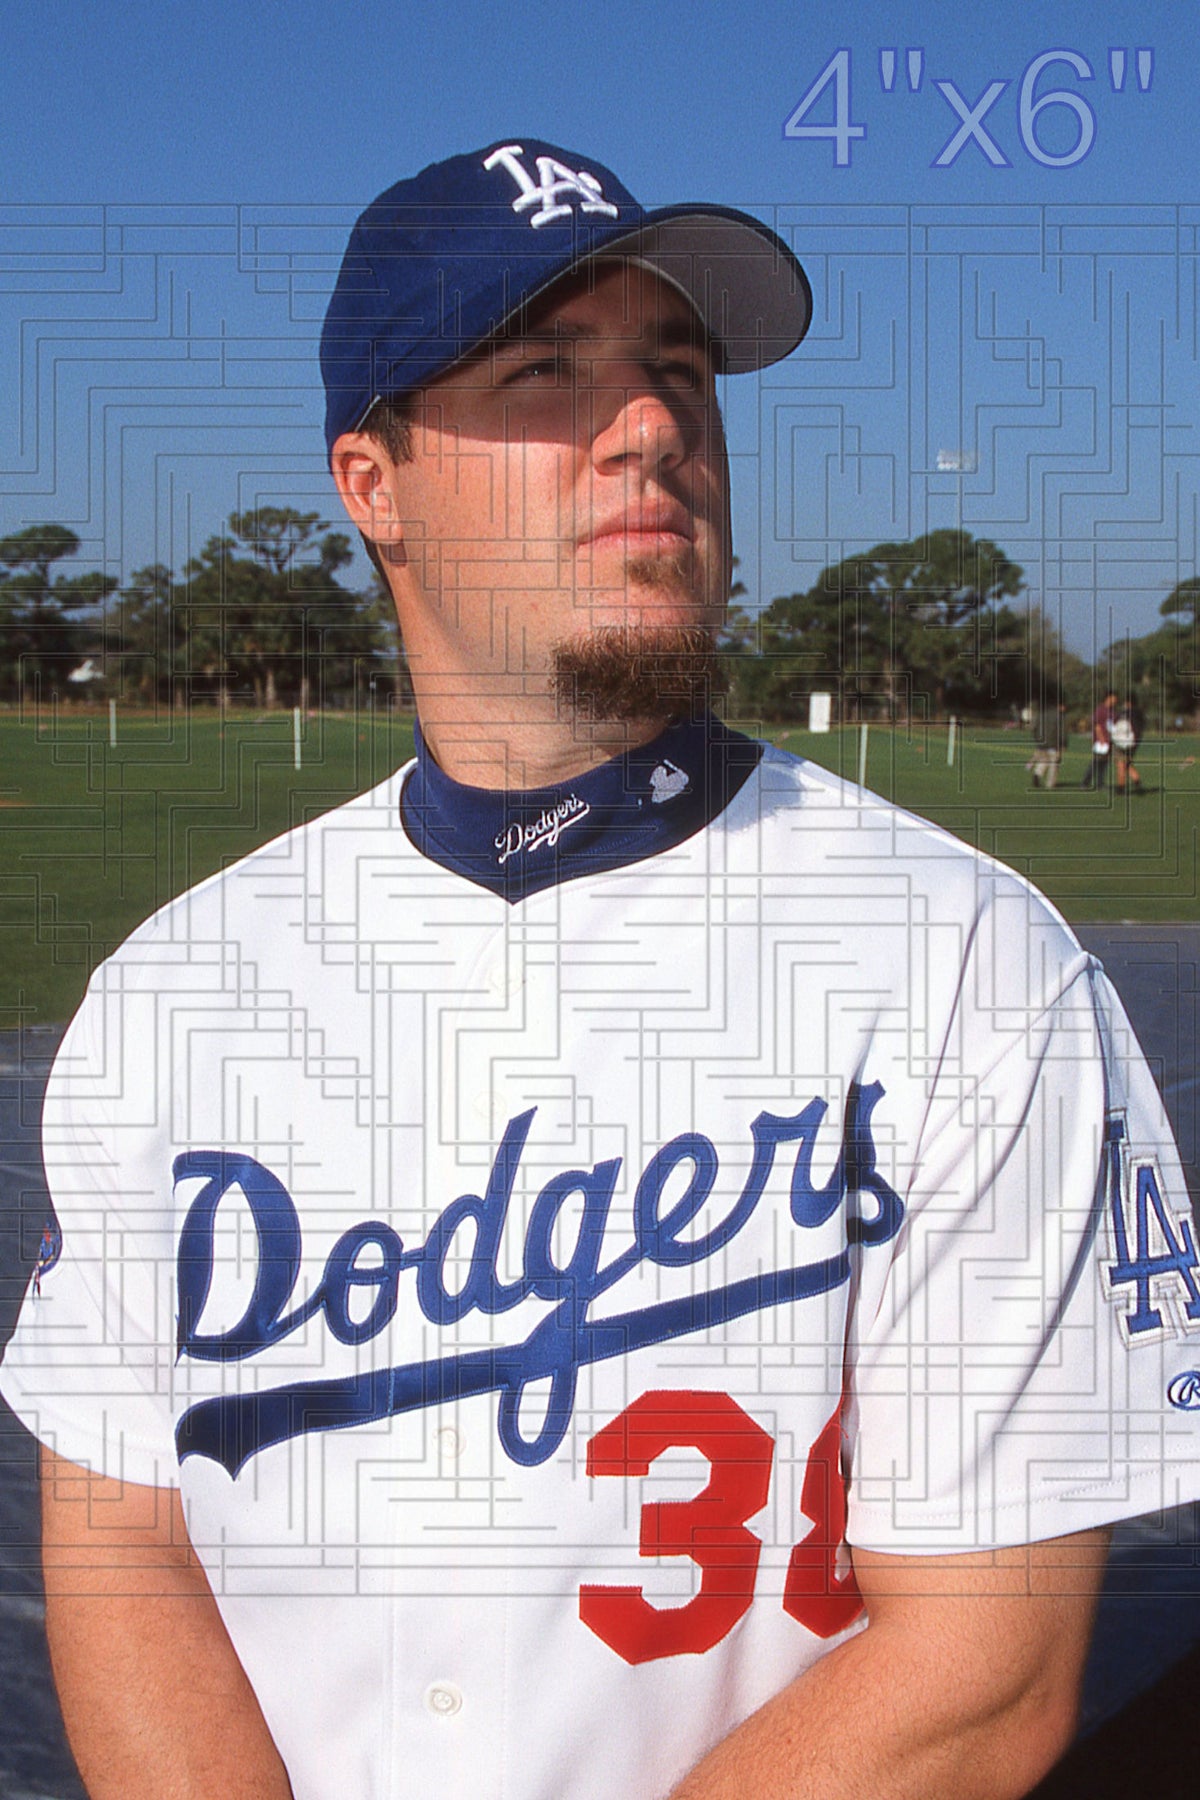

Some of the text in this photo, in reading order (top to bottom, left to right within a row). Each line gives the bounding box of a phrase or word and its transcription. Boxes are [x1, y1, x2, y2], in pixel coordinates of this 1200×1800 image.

[484, 145, 618, 229] LA
[495, 793, 590, 863] Dodgers
[173, 1080, 904, 1466] Dodgers
[1105, 1119, 1200, 1334] LA
